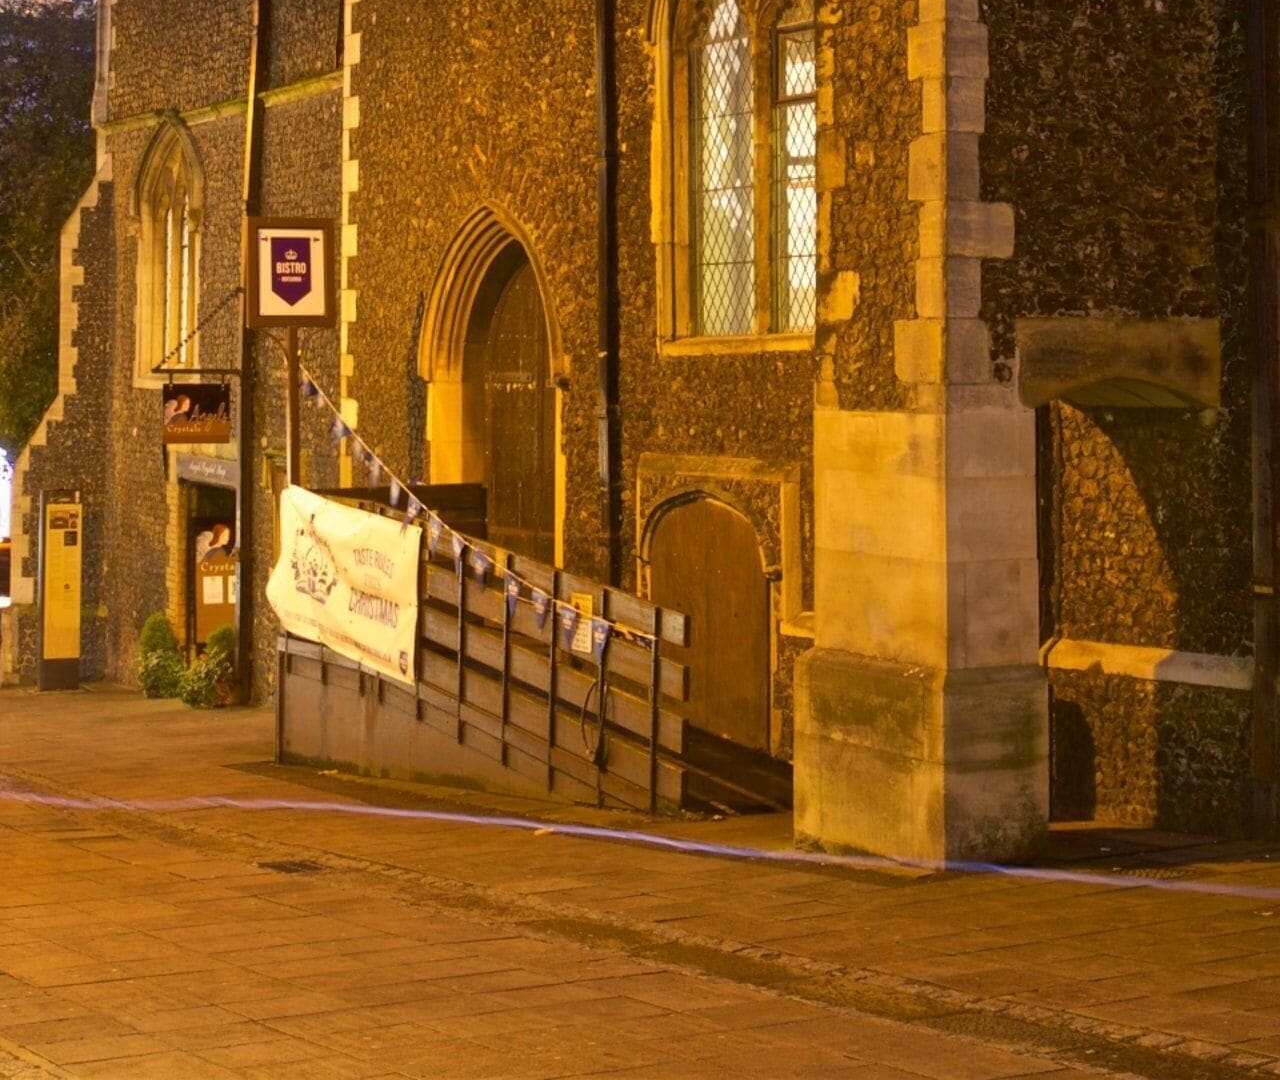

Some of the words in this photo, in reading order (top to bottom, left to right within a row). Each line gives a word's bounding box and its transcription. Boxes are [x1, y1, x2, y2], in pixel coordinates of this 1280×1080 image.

[276, 262, 306, 274] BISTRO
[167, 423, 201, 433] Crystals
[353, 548, 373, 567] TASTE
[348, 586, 399, 629] CHRISTMAS
